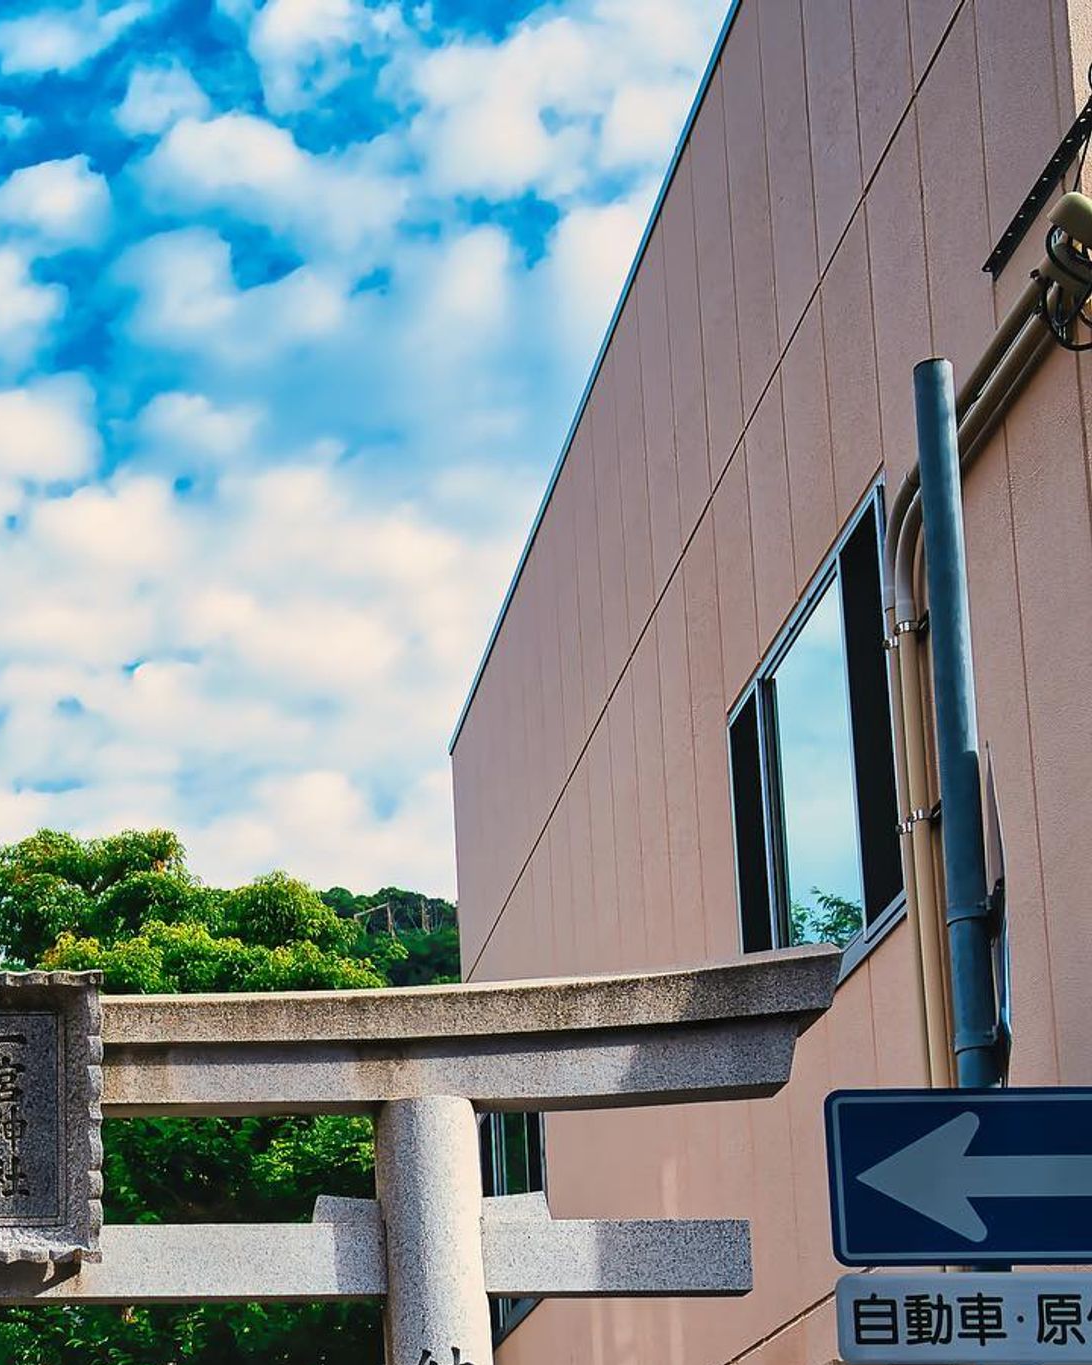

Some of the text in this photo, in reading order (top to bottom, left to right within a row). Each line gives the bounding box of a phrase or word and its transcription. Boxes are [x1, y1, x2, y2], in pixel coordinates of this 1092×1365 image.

[852, 1291, 1092, 1347] 自動車・原
